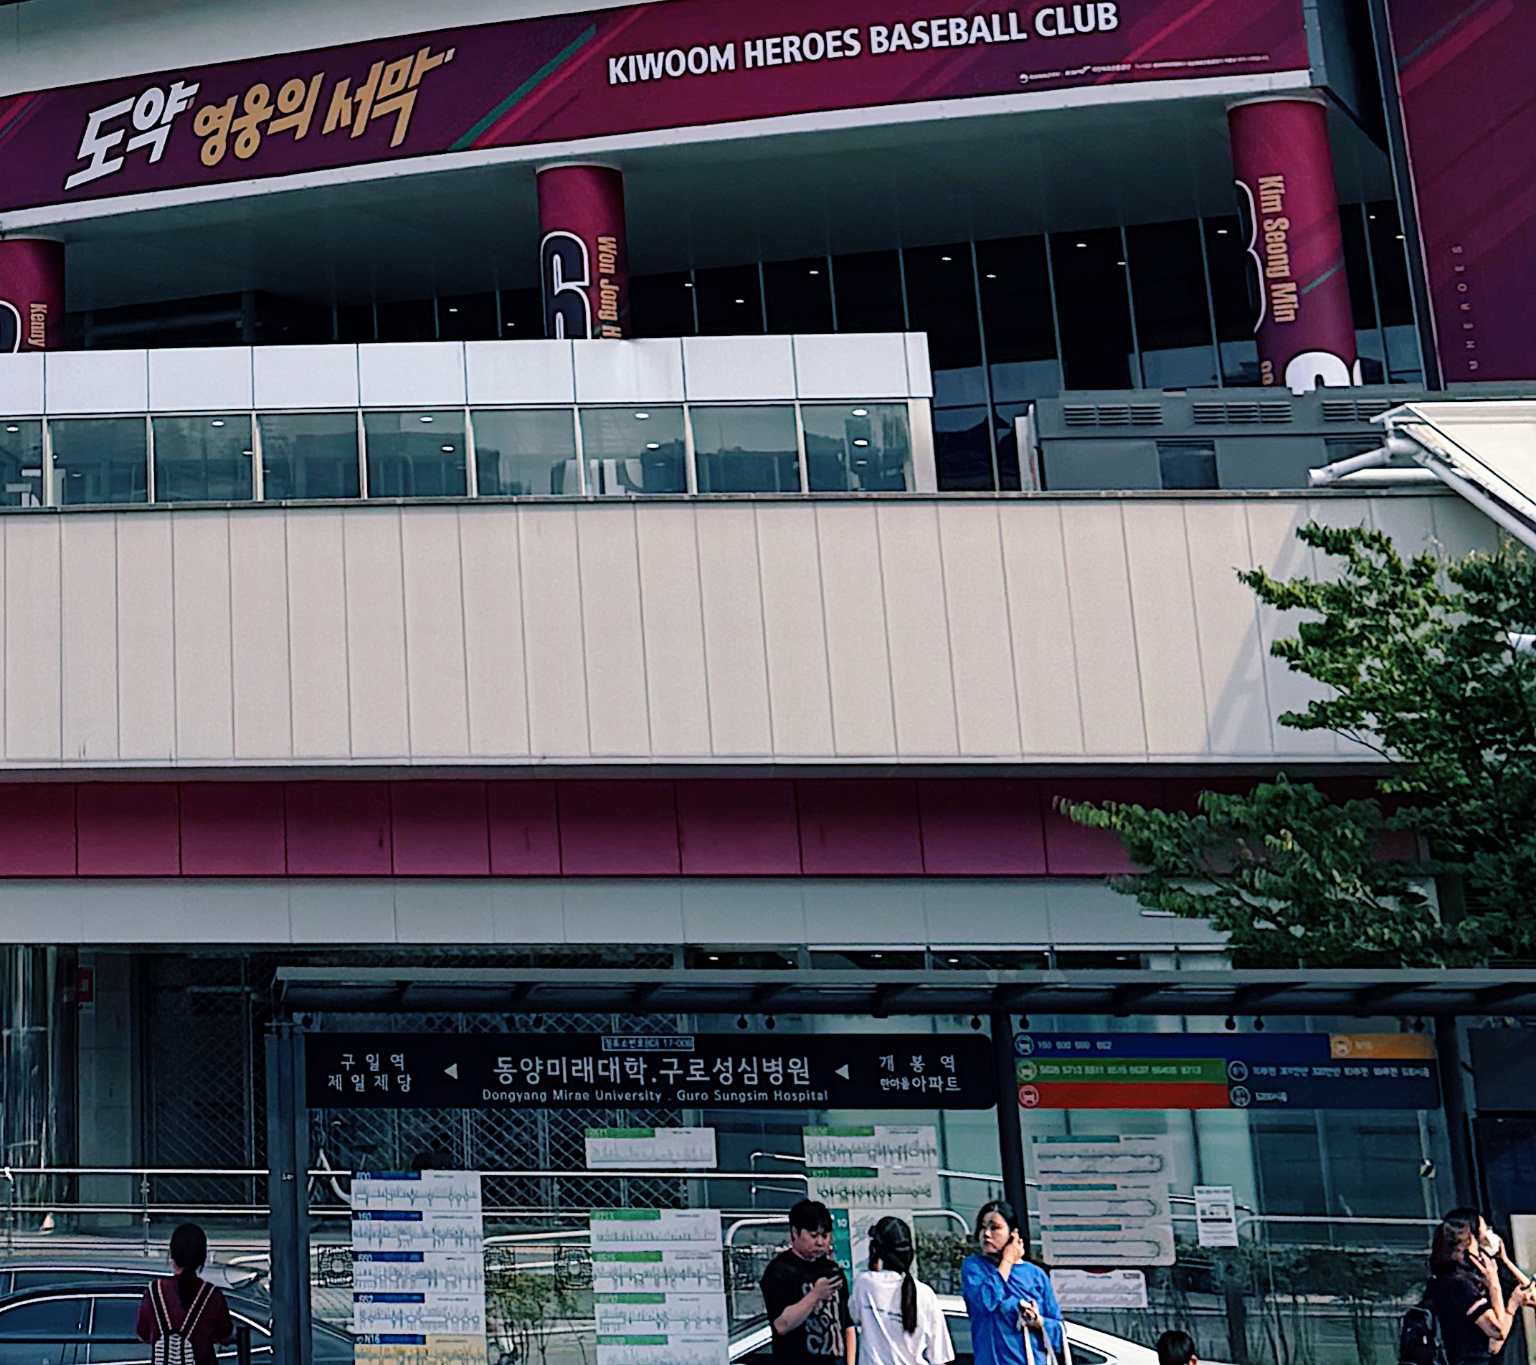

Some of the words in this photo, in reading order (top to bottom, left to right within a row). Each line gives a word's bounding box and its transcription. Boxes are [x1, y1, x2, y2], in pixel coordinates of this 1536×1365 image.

[607, 43, 735, 86] KIWOOM
[743, 27, 859, 70] HEROES
[869, 11, 1027, 55] BASEBALL
[1035, 1, 1120, 38] CLUB
[64, 79, 200, 191] 도약
[193, 71, 325, 167] 영웅의
[321, 46, 456, 148] 서막
[1257, 174, 1287, 214] Kim
[596, 235, 619, 275] Won
[1262, 216, 1292, 279] Seong
[597, 278, 621, 322] Jong
[1270, 281, 1300, 324] Min
[27, 303, 48, 348] Kenny
[482, 1089, 547, 1104] Dongyang
[552, 1089, 590, 1101] Mirae
[595, 1089, 663, 1103] University
[676, 1089, 709, 1102] Guro
[713, 1089, 771, 1103] Sungsim
[773, 1089, 829, 1103] Hospital
